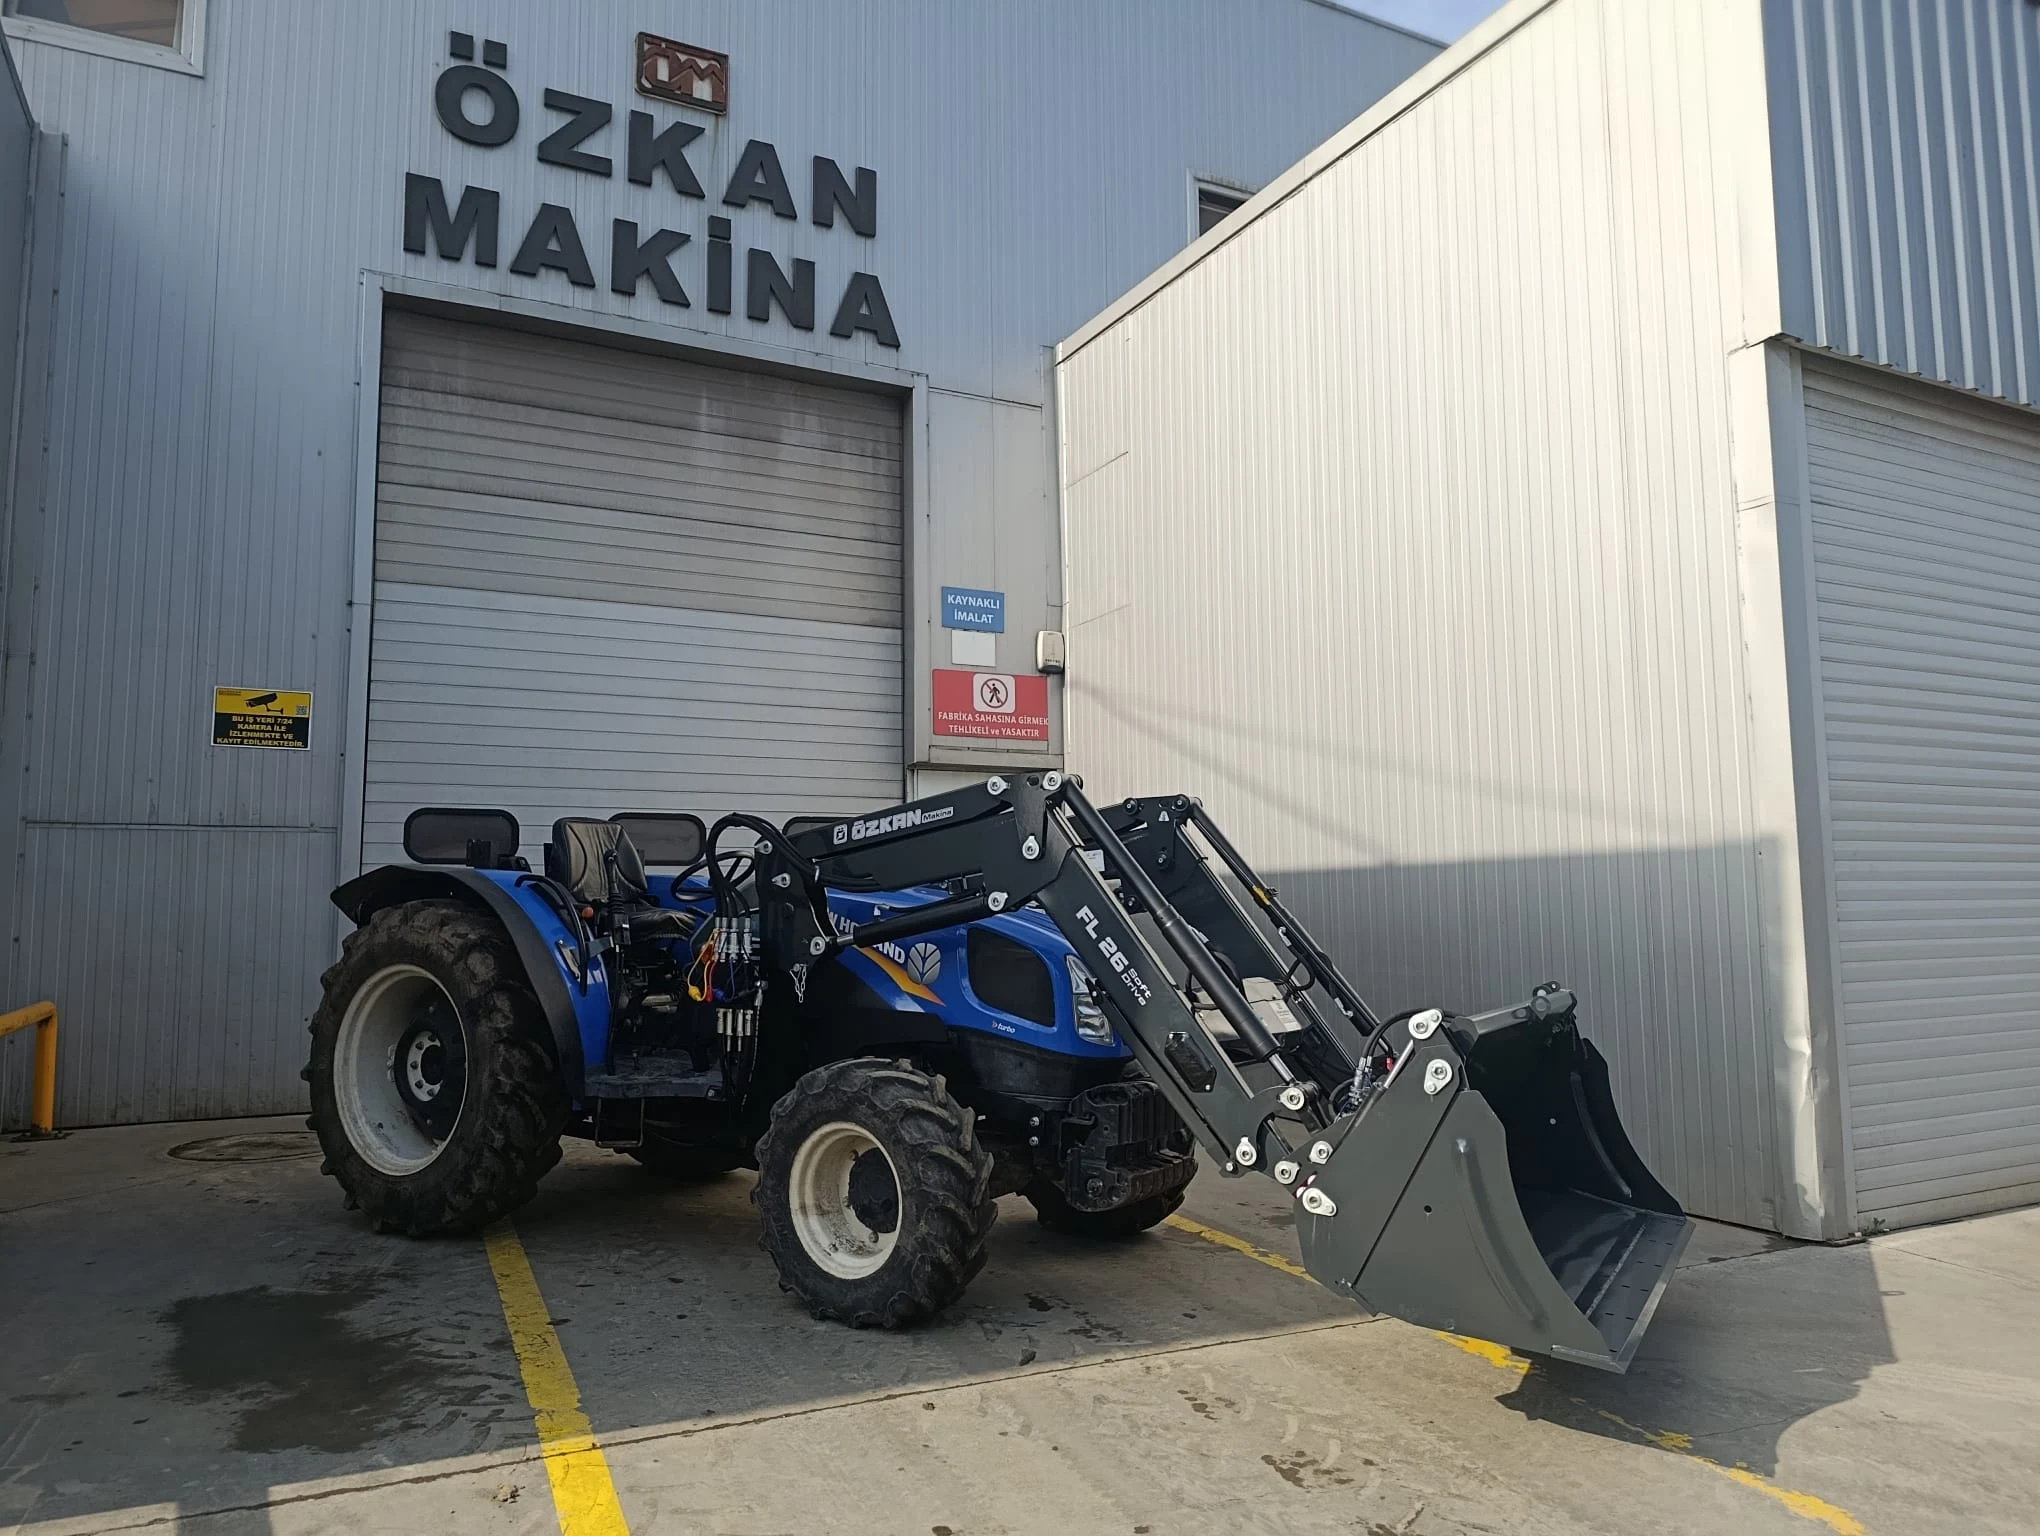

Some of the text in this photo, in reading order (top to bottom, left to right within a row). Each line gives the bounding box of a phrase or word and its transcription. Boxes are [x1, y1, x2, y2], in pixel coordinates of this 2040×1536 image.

[435, 30, 877, 238] ÖZKAN
[403, 171, 900, 350] MAKİNA
[947, 594, 1000, 609] KAYNAKLI
[954, 609, 994, 624] İMALAT
[938, 711, 973, 722] FABRİKA
[975, 712, 1016, 724] SAHASINA
[948, 724, 989, 735] TEHLİKELİ
[1001, 728, 1040, 737] YASAKTIR
[229, 730, 281, 738] İZLENMEKTE
[851, 809, 921, 840] ÖZKAN
[922, 808, 953, 823] Makina
[1075, 905, 1129, 973] FL 26
[1121, 973, 1147, 1006] Drive
[1128, 968, 1152, 999] Soft
